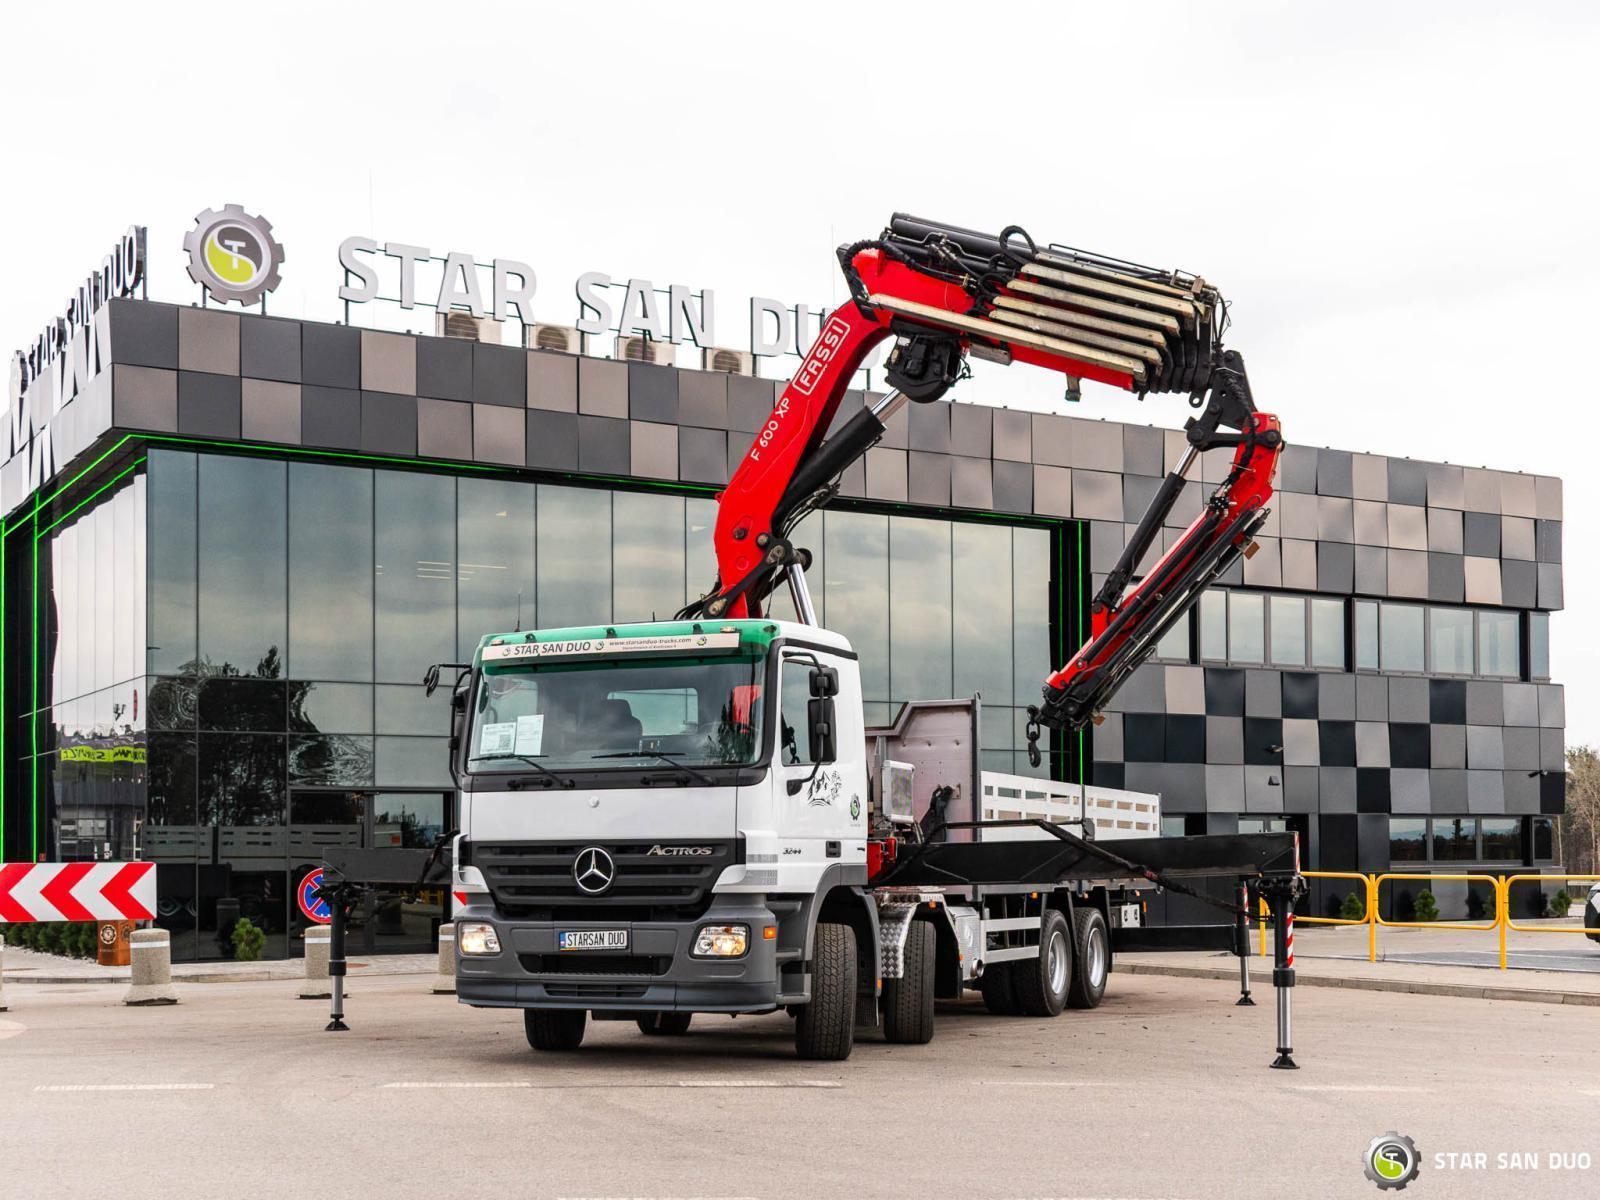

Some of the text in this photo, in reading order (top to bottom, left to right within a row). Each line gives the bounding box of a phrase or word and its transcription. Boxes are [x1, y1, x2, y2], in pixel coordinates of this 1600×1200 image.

[100, 224, 146, 306] DUO
[339, 235, 537, 326] STAR
[576, 271, 715, 350] SAN
[800, 324, 844, 388] FASSI
[774, 397, 791, 419] XP
[513, 641, 591, 656] STAR SAN DUO
[608, 930, 626, 945] DUO
